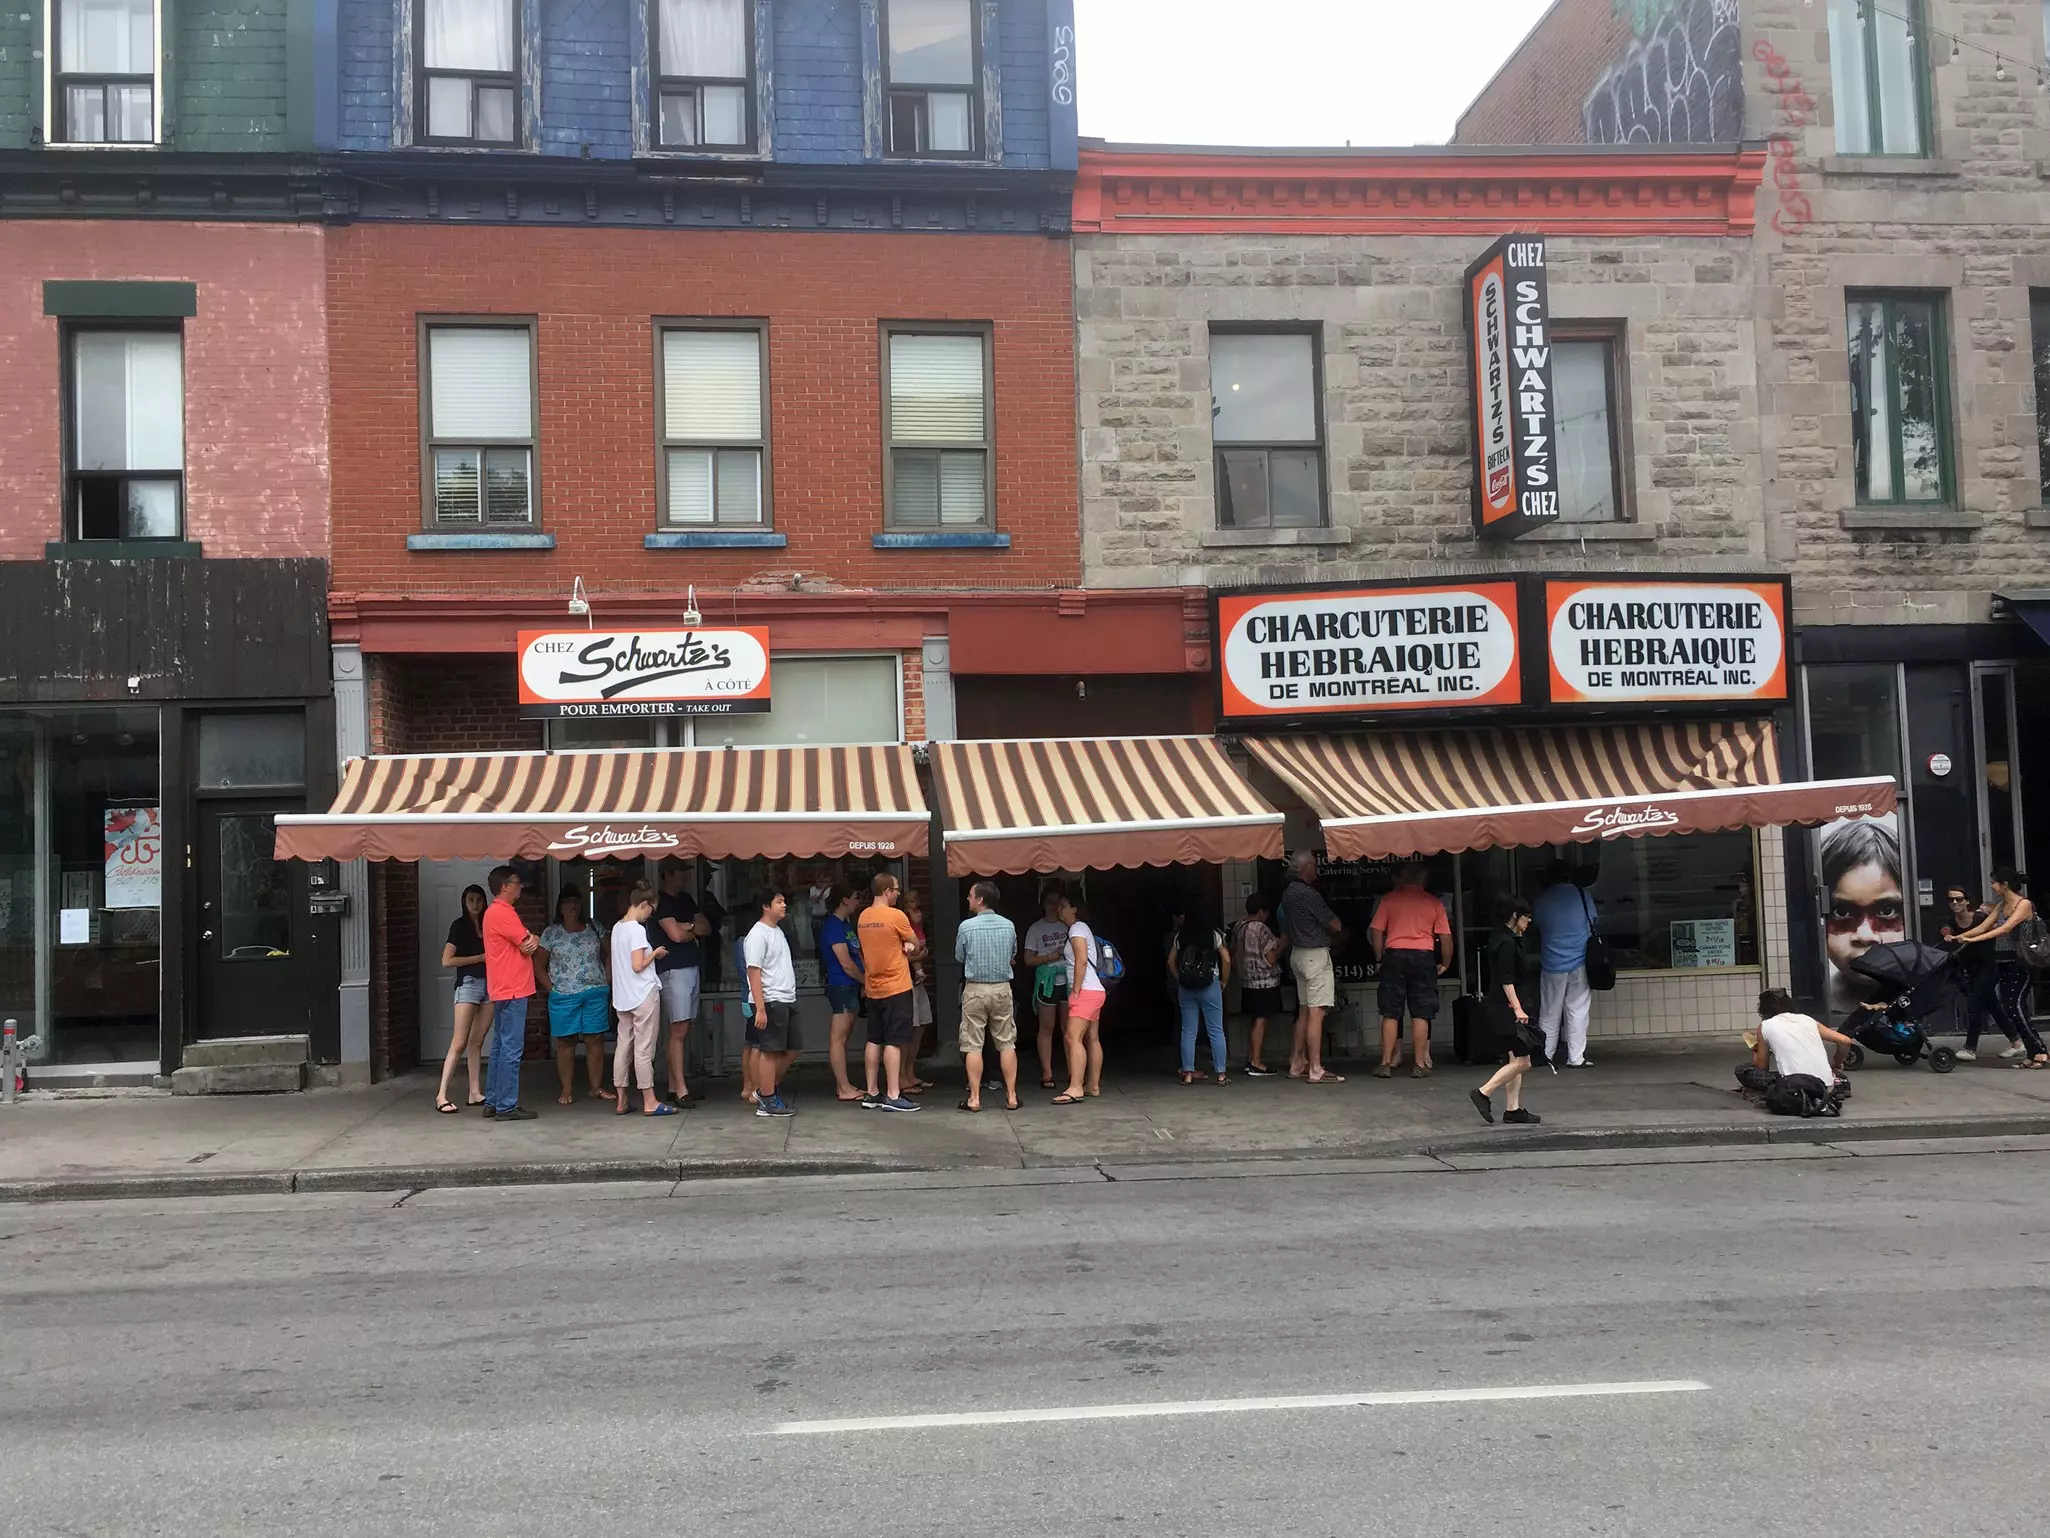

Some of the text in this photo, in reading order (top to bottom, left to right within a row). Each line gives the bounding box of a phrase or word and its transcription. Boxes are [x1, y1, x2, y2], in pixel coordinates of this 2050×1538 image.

[1508, 243, 1544, 267] CHEZ
[1485, 282, 1505, 445] SCHWARTZ'S
[1512, 280, 1549, 486] SCHWARTZ'S
[1487, 445, 1510, 470] BIFTECK
[1521, 491, 1557, 516] CHEZ
[1246, 604, 1489, 644] CHARCUTERIE
[1568, 602, 1762, 630] CHARCUTERIE
[1260, 641, 1481, 678] HEBRAIQUE
[1580, 637, 1756, 669] HEBRAIQUE
[534, 632, 731, 700] CHEZ Schwartz's
[1588, 668, 1756, 687] DE MONTRÉAL INC.
[704, 678, 751, 690] À CÔTÉ
[1269, 675, 1480, 700] DE MONTRÉAL INC.
[559, 704, 597, 715] POUR
[601, 703, 675, 715] EMPORTER
[686, 704, 708, 712] TAKE
[711, 704, 732, 712] OUT
[1571, 805, 1679, 837] Schwartz's
[1835, 805, 1857, 813] DEPUIS
[547, 825, 679, 856] Schwartz's
[849, 841, 895, 850] DEPUIS 1928
[1317, 866, 1357, 876] Catering
